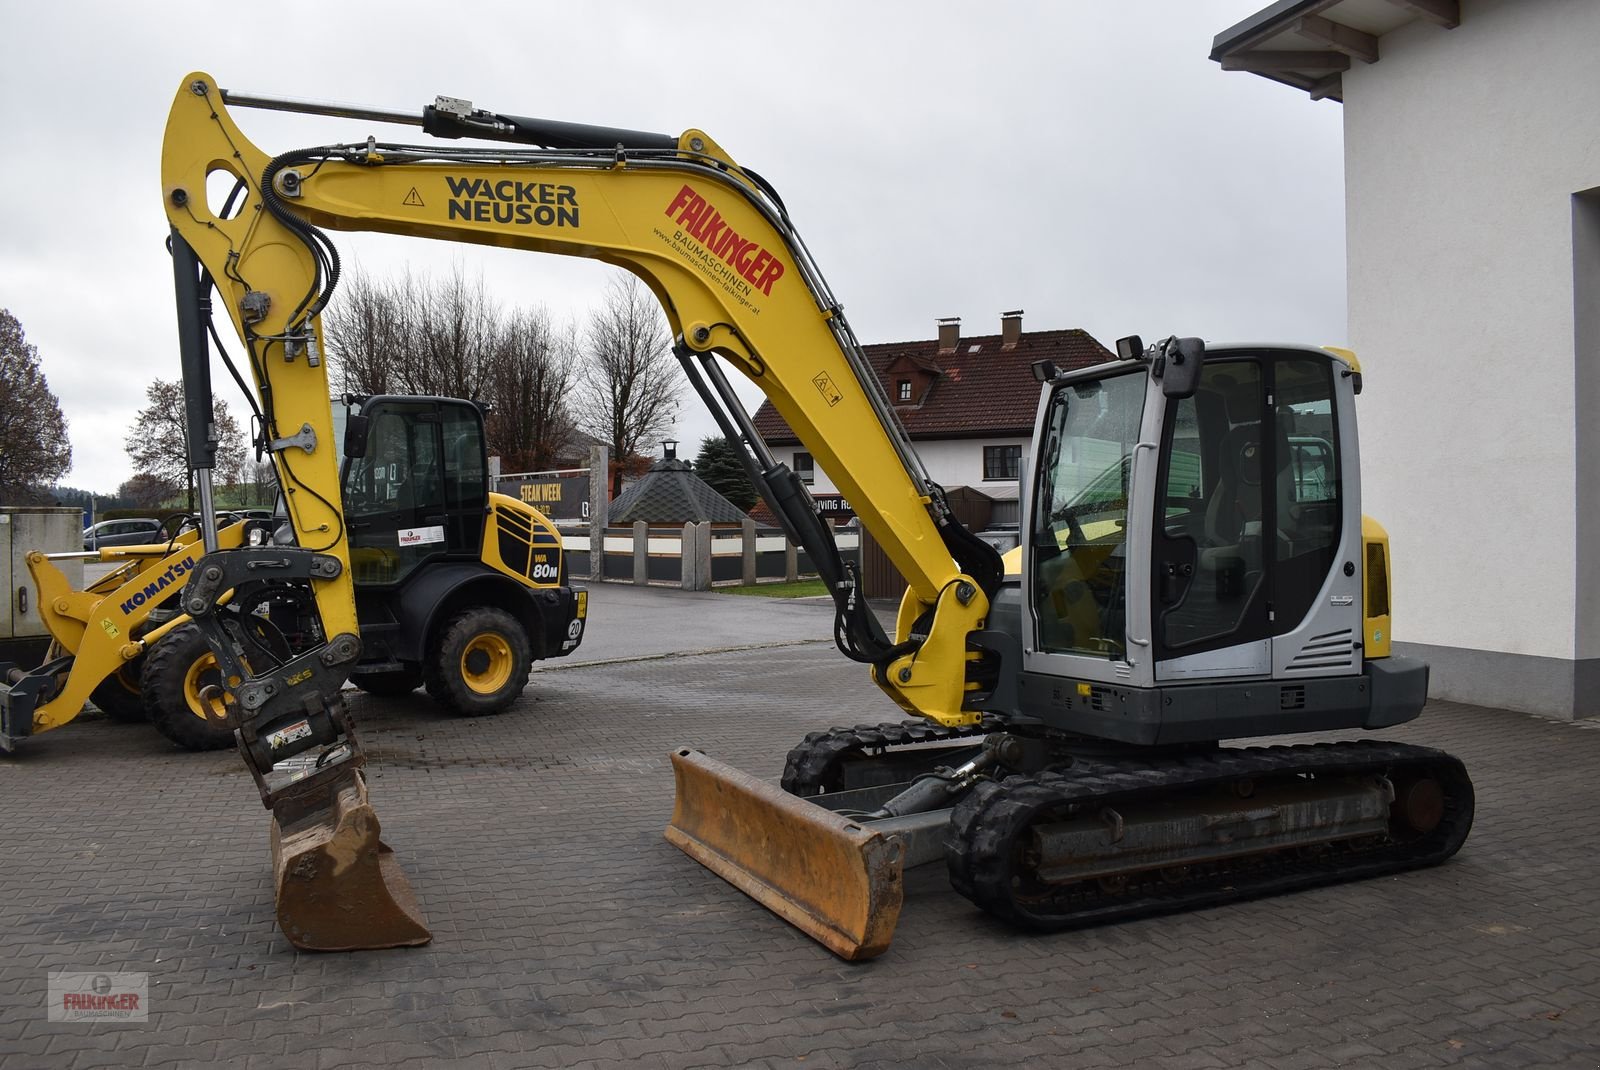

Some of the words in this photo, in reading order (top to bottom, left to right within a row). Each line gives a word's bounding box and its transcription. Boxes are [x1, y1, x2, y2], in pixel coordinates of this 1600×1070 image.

[445, 176, 579, 206] WACKER
[449, 199, 579, 228] NEUSON
[664, 184, 785, 297] FALKINGER
[653, 227, 760, 316] www.baumaschinen-falkinger.at
[673, 230, 752, 296] BAUMASCHINEN
[520, 484, 541, 502] STEAK
[541, 483, 561, 502] WEEK
[535, 554, 547, 563] WA
[120, 556, 195, 615] KOMATSU
[570, 622, 580, 636] 20
